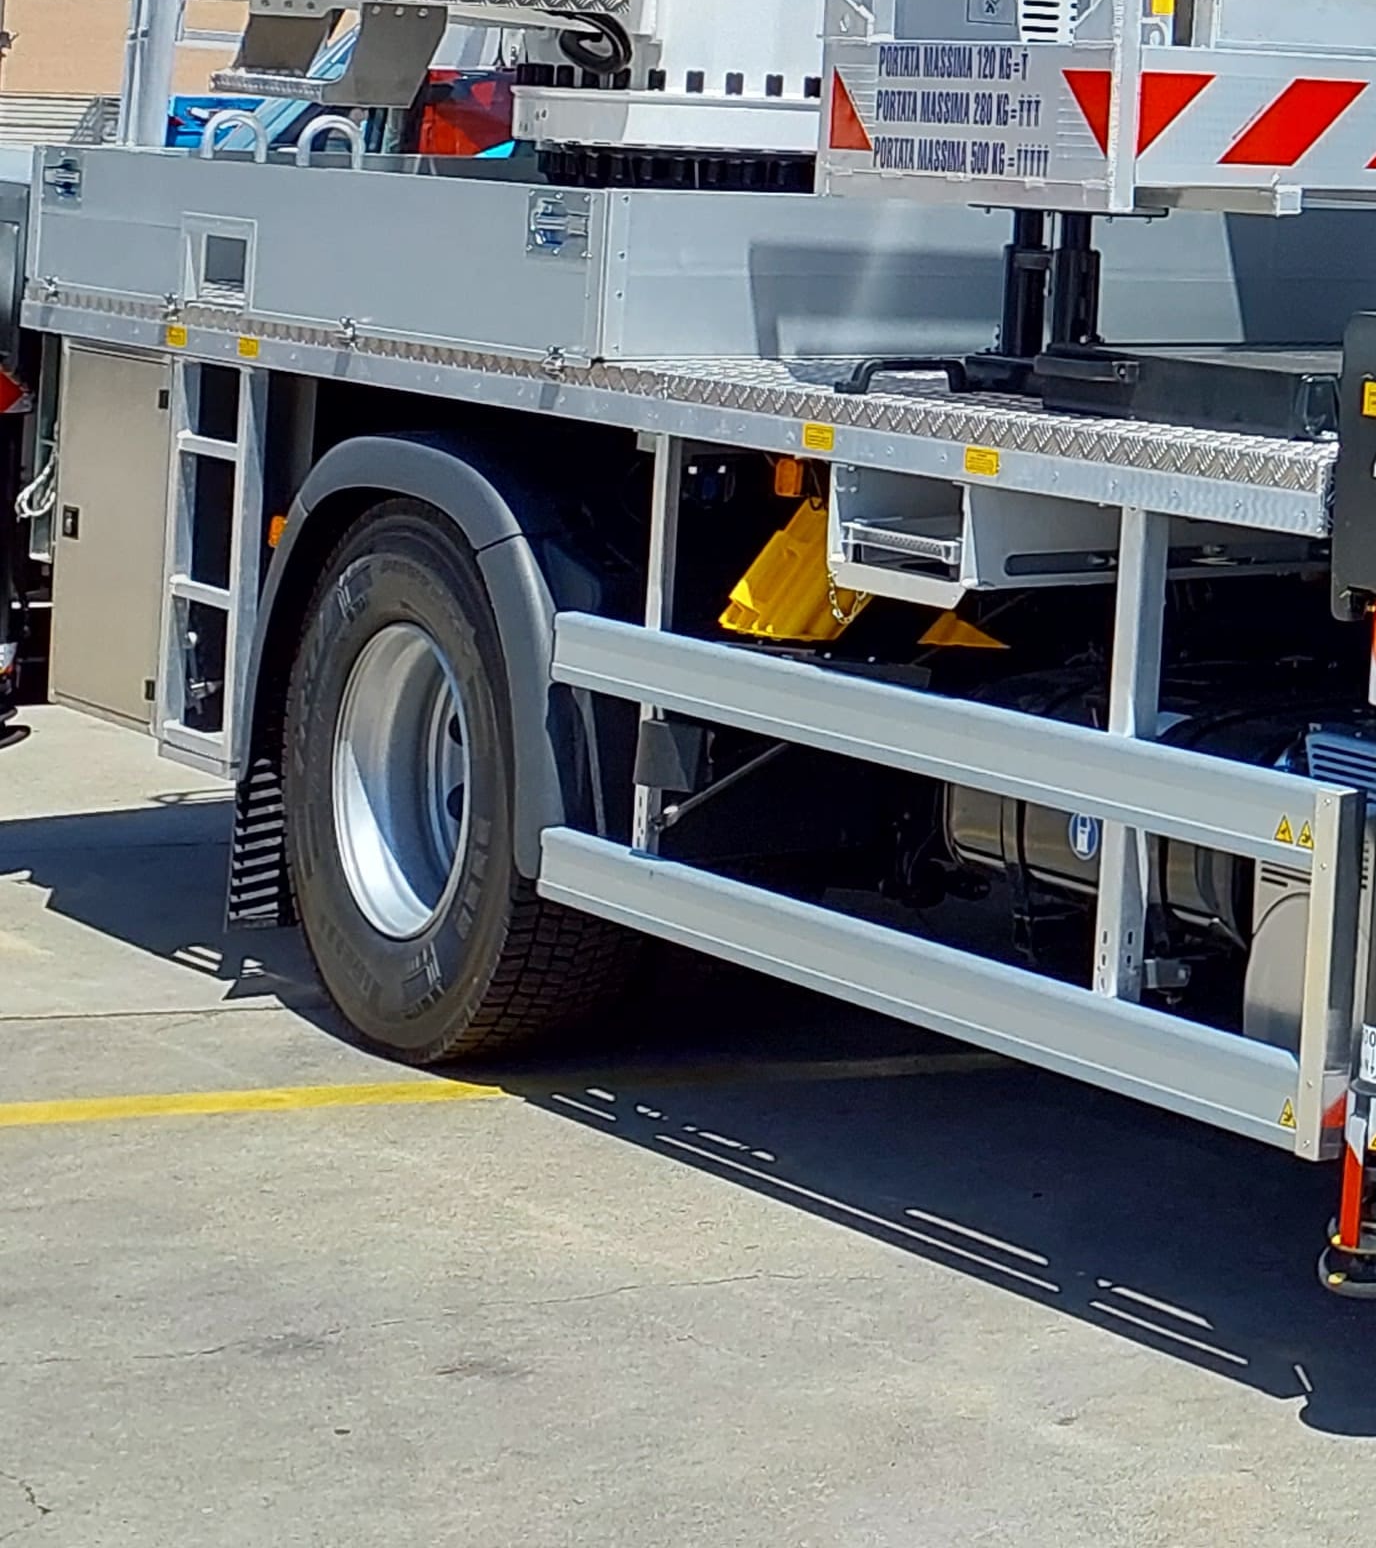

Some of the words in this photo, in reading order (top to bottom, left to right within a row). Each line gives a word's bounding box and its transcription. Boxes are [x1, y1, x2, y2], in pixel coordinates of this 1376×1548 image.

[878, 45, 920, 78] PORTATA
[923, 46, 972, 79] MASSIMA
[977, 48, 996, 80] 120
[875, 89, 917, 122] PORTATA
[920, 91, 970, 124] MASSIMA
[973, 92, 993, 126] 280
[872, 136, 915, 169] PORTATA
[917, 138, 967, 173] MASSIMA
[970, 141, 990, 174] 500
